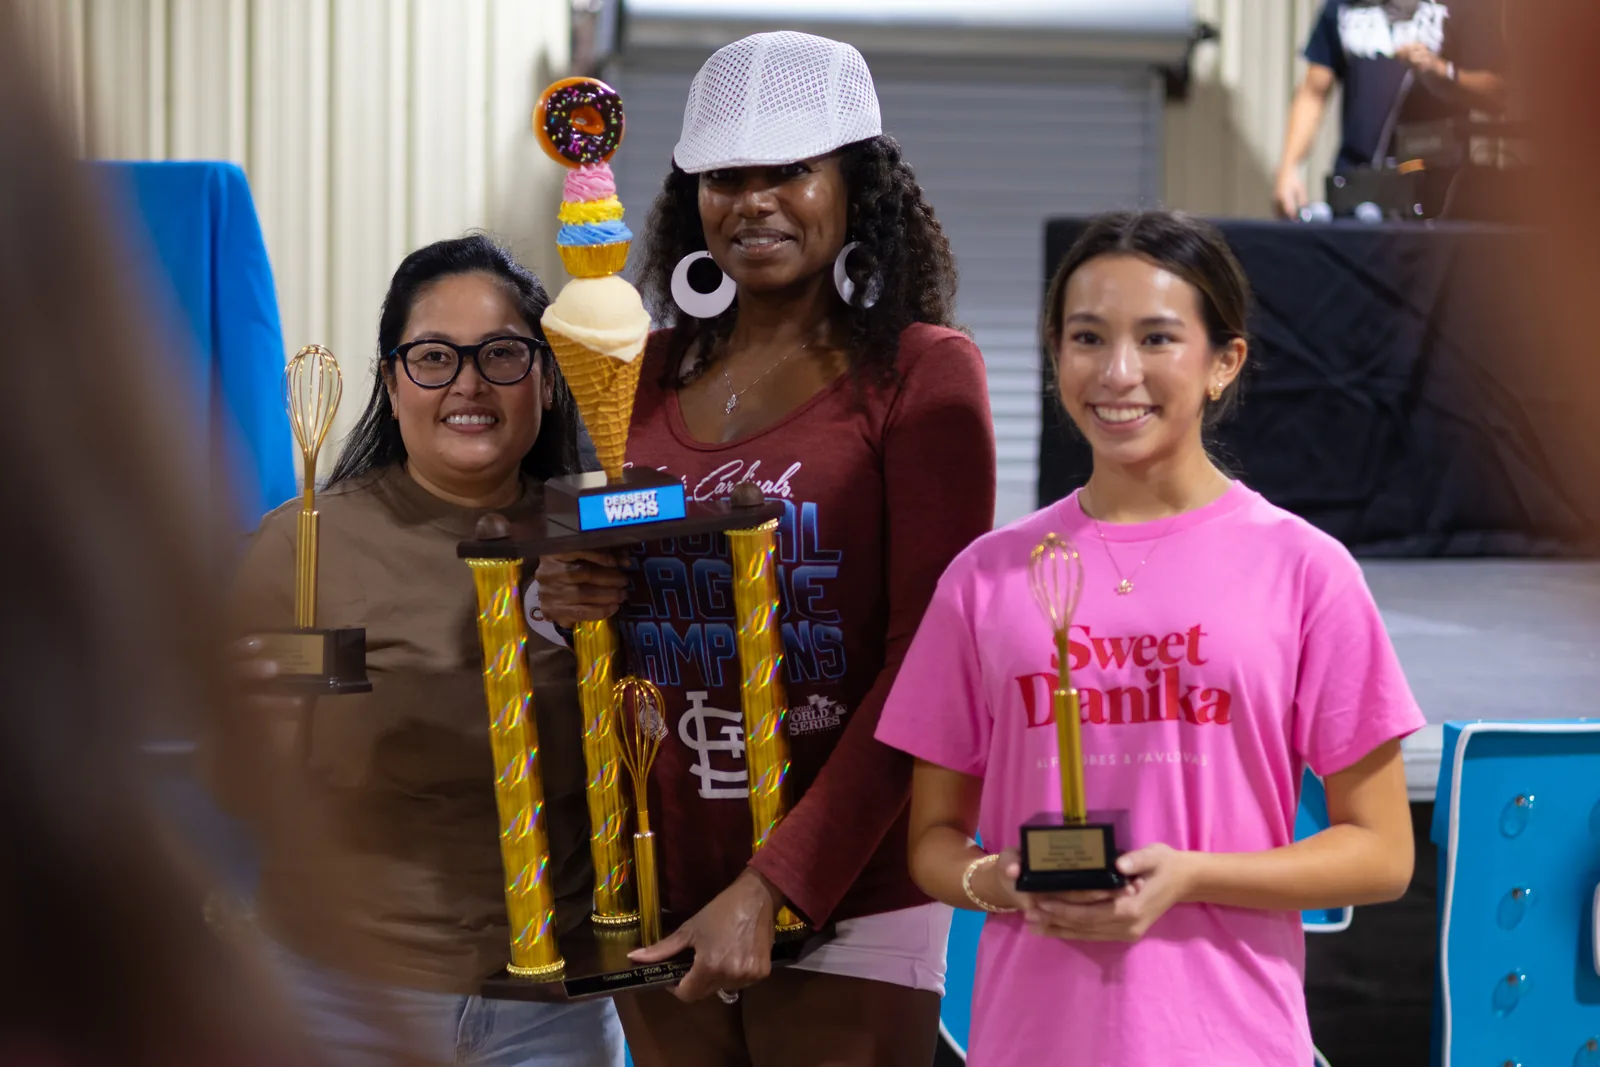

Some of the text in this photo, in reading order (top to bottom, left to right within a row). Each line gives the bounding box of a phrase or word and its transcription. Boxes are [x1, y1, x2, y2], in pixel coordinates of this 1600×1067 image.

[603, 490, 658, 507] DESSERT
[604, 500, 659, 523] WARS
[1050, 624, 1209, 671] Sweet
[1015, 665, 1233, 728] Danika
[788, 707, 830, 724] ORLD
[789, 715, 841, 736] SERIES
[603, 971, 632, 982] Season
